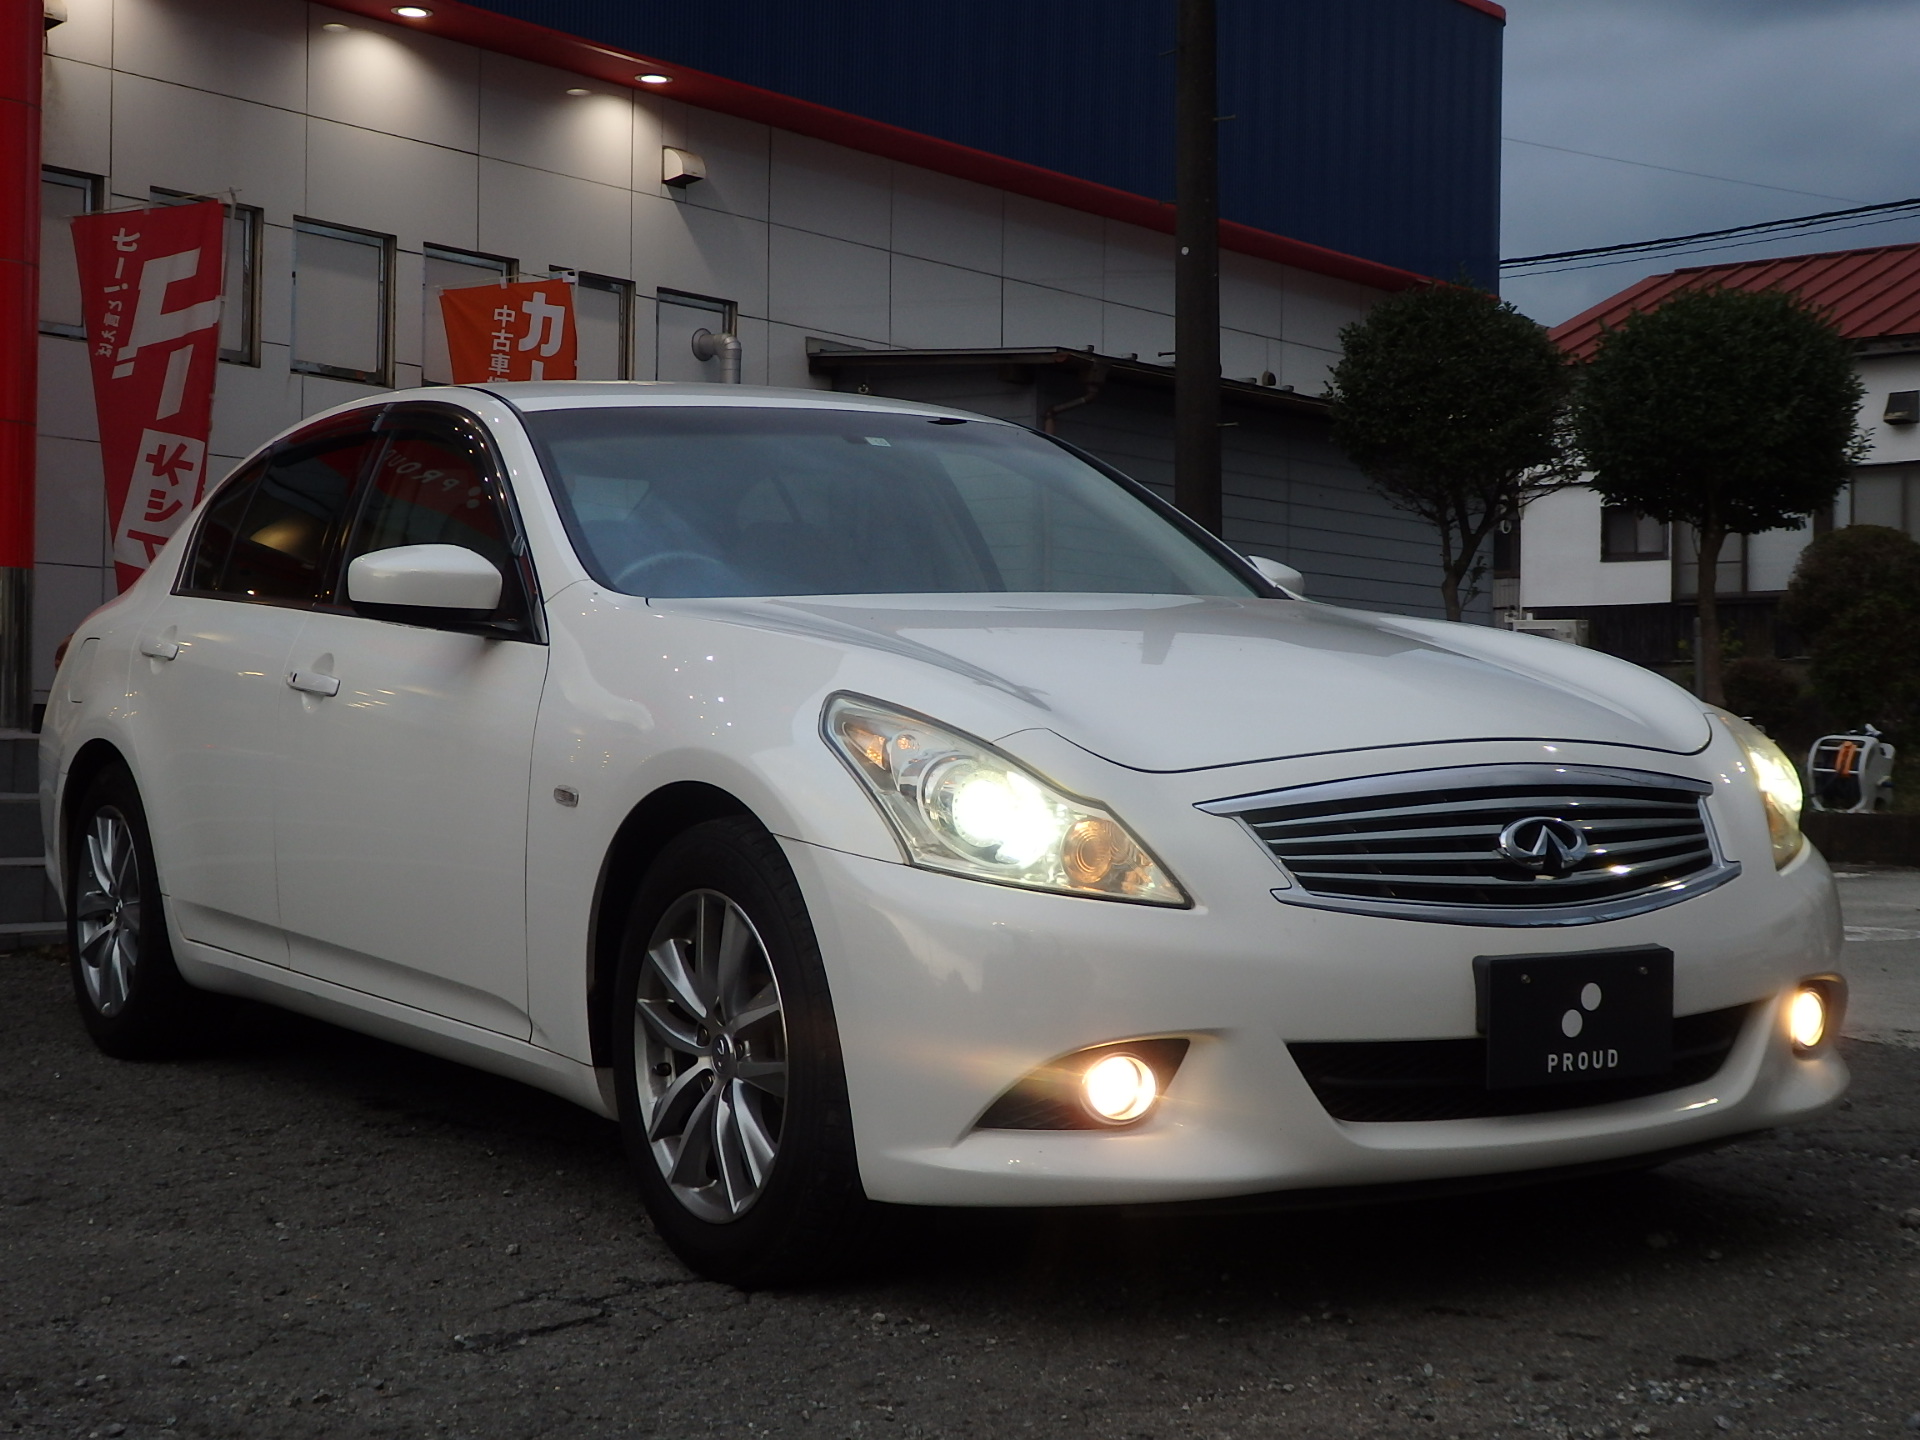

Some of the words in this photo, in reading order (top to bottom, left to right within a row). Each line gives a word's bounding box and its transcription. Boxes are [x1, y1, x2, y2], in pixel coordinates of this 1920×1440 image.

[487, 304, 516, 383] 中古車
[1547, 1048, 1619, 1073] PROUD
